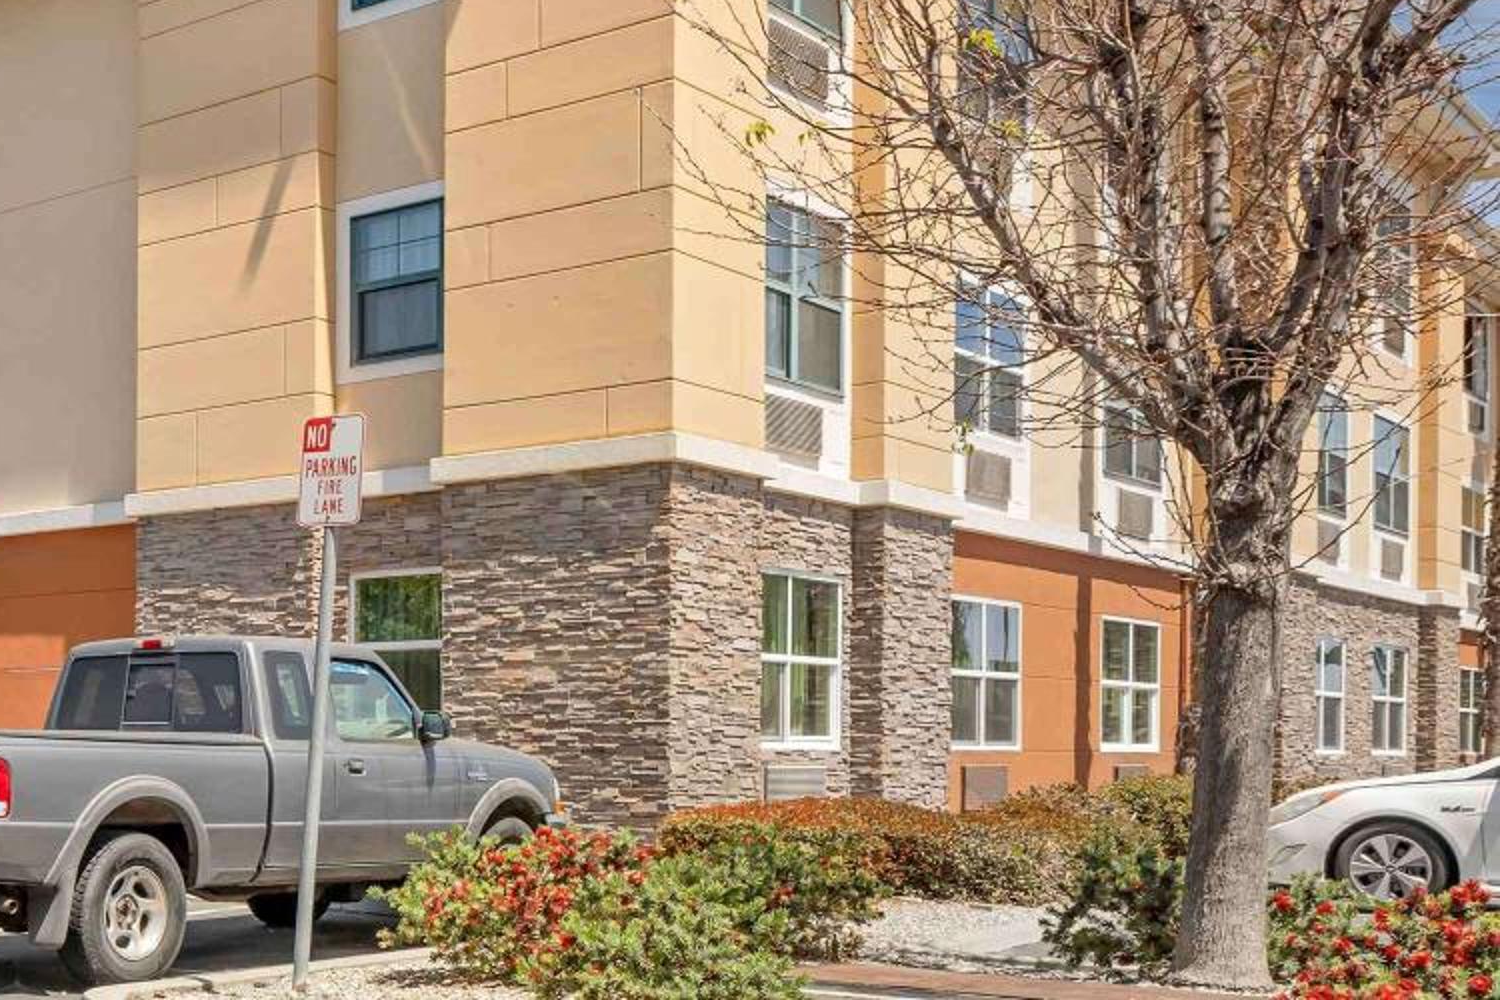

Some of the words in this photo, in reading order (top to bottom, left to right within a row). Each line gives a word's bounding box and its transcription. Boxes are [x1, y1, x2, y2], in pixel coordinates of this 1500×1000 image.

[307, 423, 328, 449] NO
[306, 455, 357, 478] PARKING
[317, 479, 342, 495] FIRE
[314, 498, 344, 515] LANE
